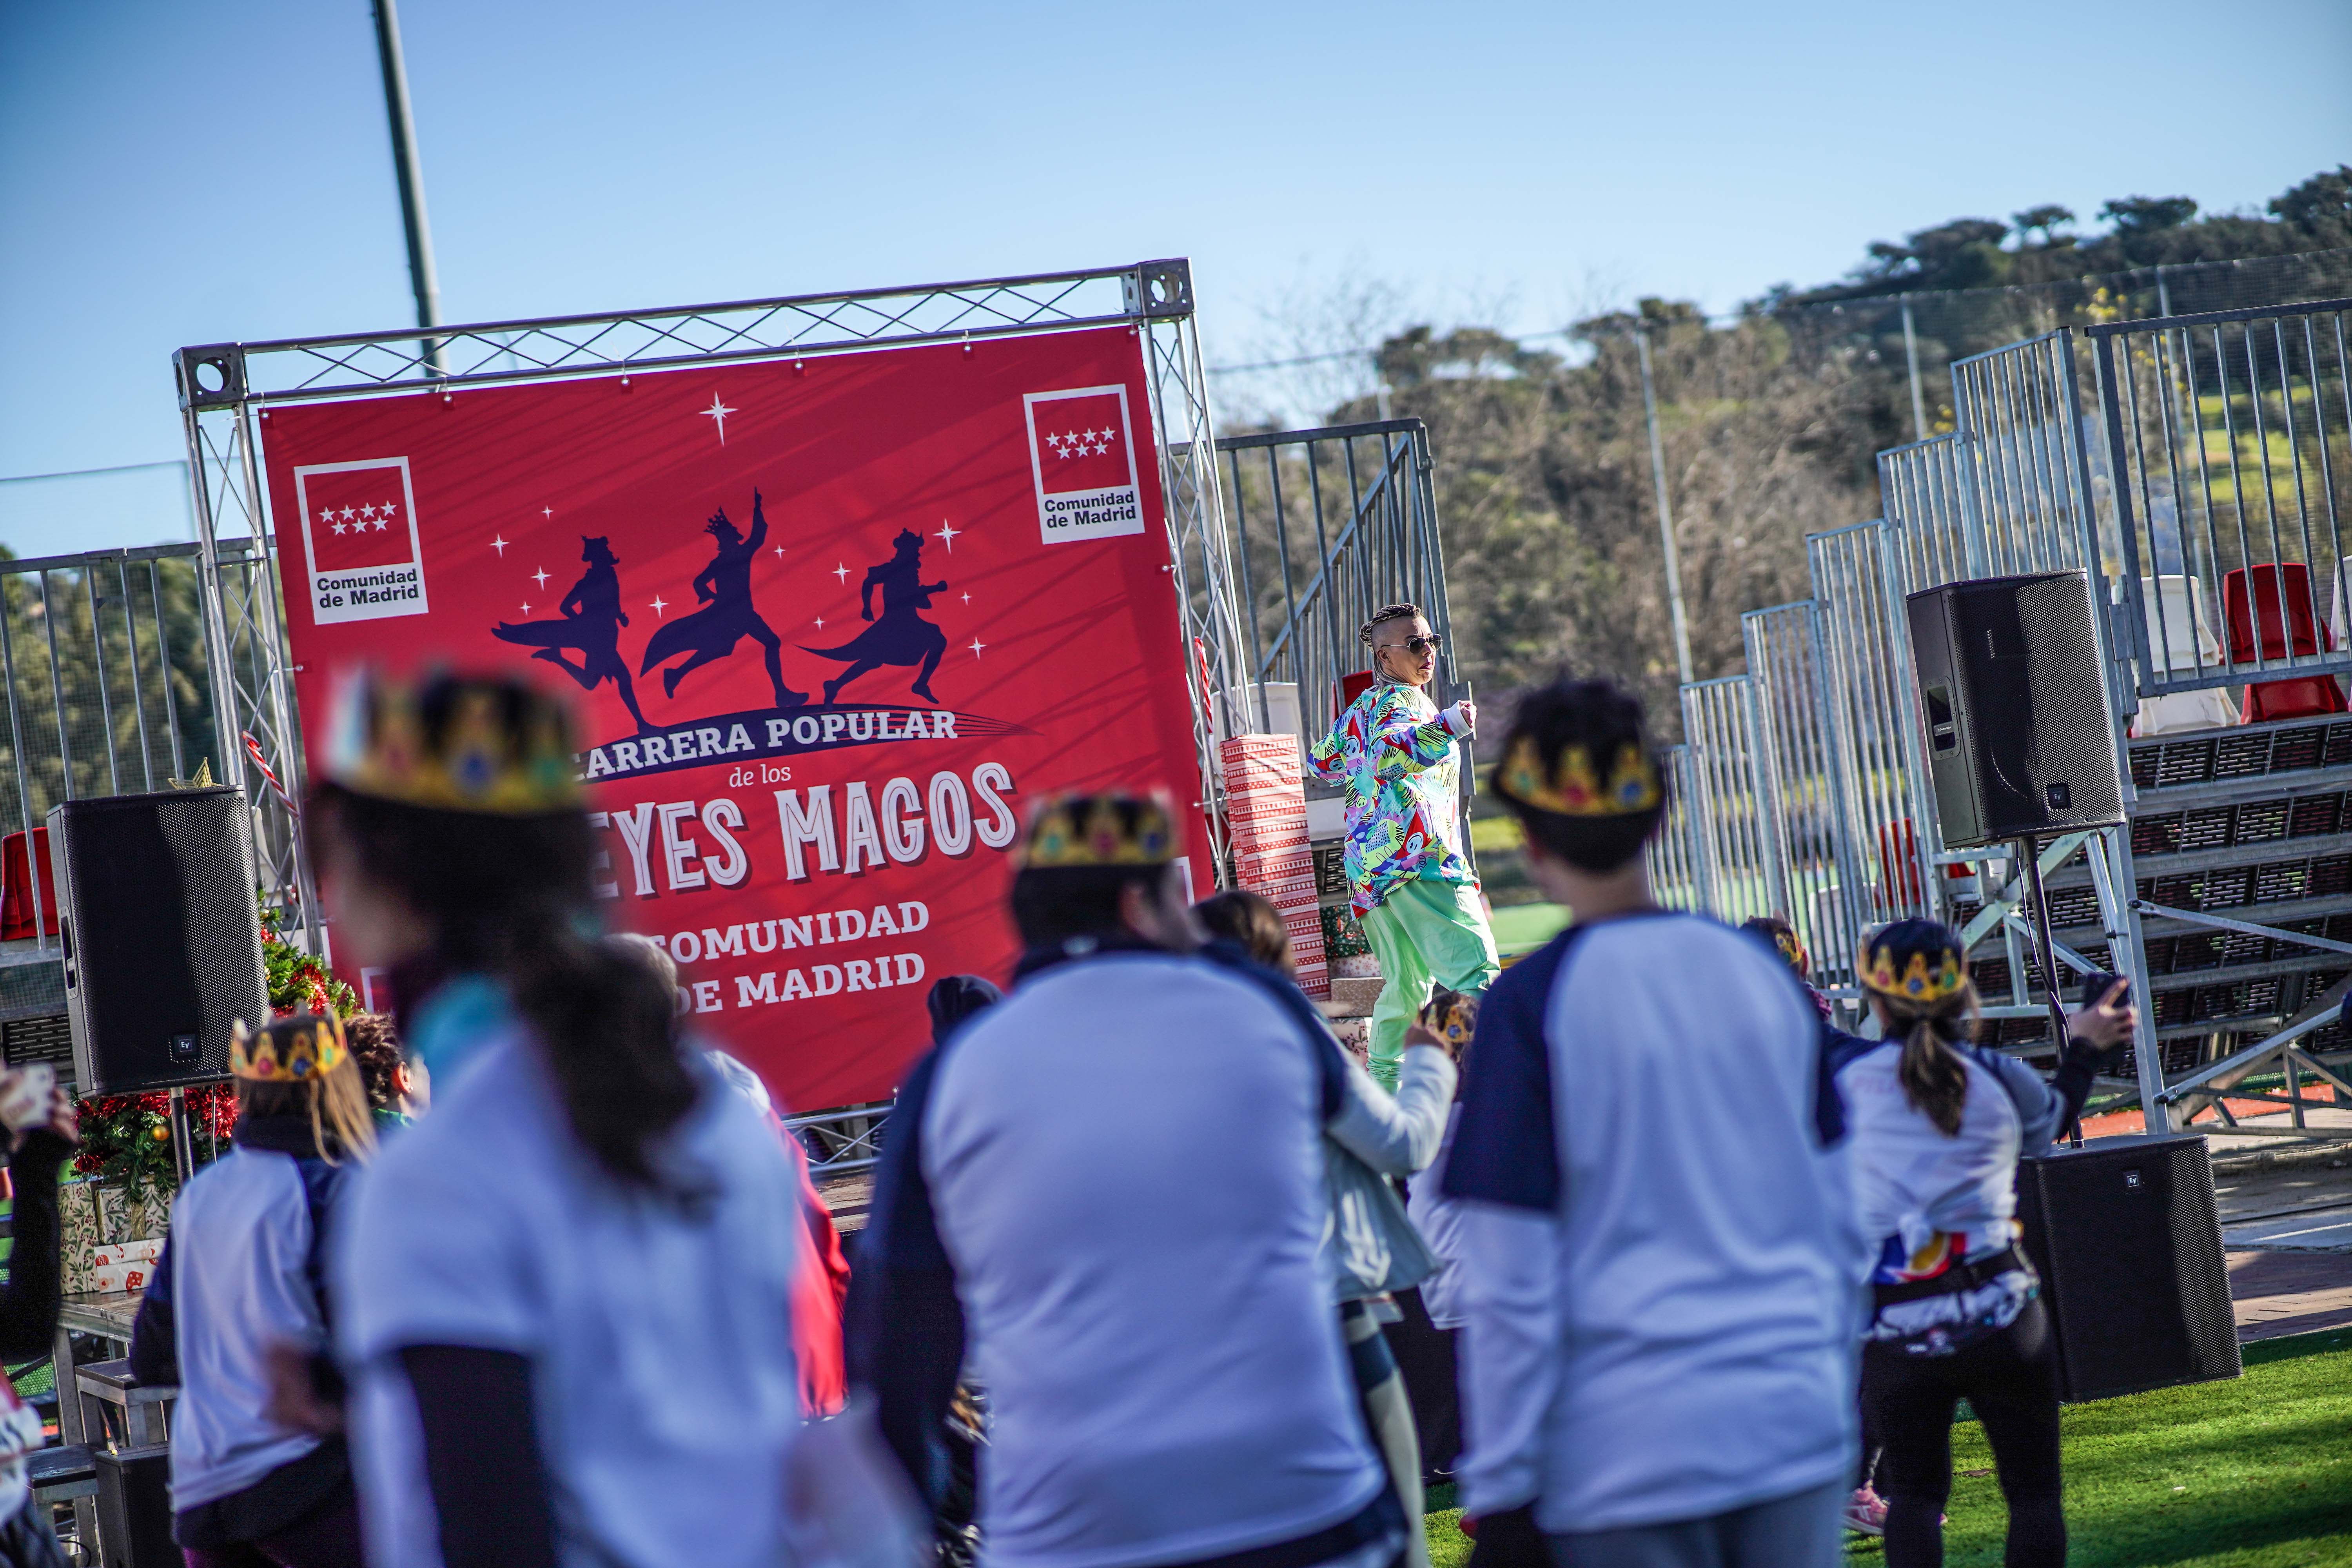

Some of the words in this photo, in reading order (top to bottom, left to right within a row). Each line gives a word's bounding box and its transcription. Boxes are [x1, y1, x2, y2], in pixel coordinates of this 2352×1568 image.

[1045, 491, 1135, 512] Comunidad
[1047, 514, 1068, 528] de
[1074, 506, 1136, 525] Madrid
[317, 568, 417, 591] Comunidad
[319, 593, 344, 608] de
[350, 584, 419, 605] Madrid
[765, 711, 958, 748] POPULAR
[729, 767, 754, 788] de
[760, 763, 791, 784] los
[586, 798, 747, 898] EYES
[773, 762, 1016, 880] MAGOS
[648, 900, 929, 963] OMUNIDAD
[735, 952, 925, 1008] MADRID
